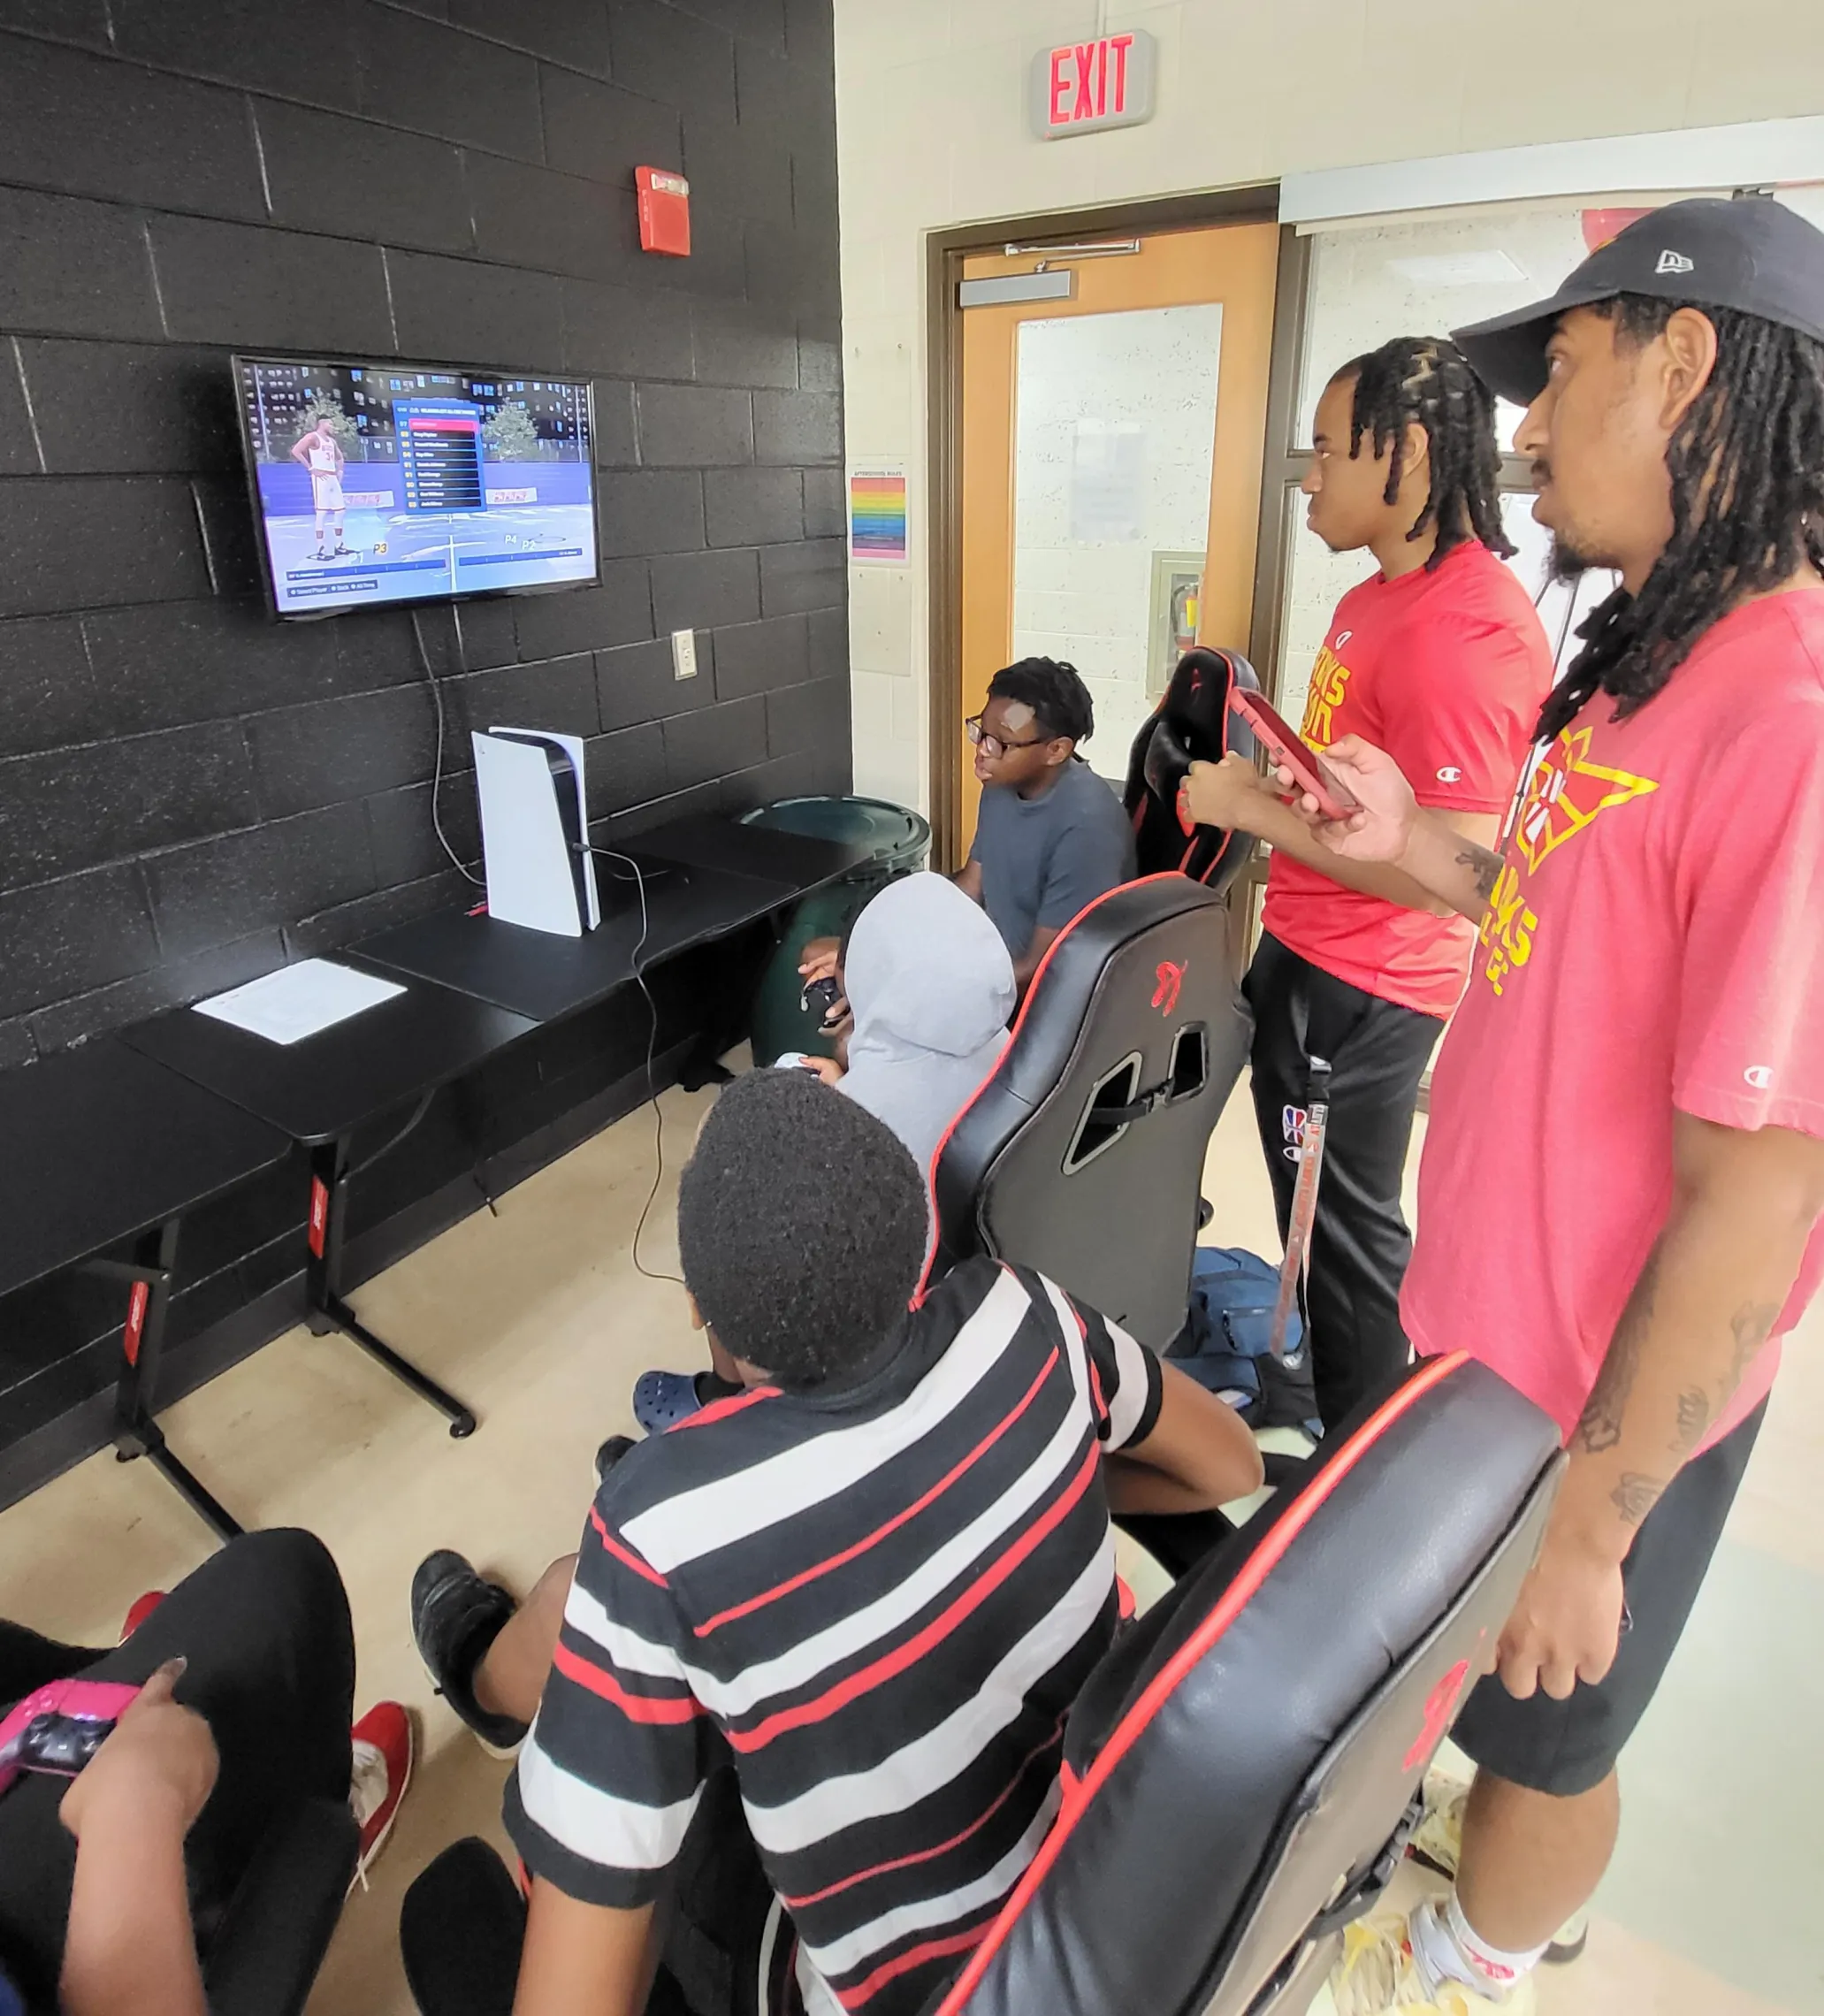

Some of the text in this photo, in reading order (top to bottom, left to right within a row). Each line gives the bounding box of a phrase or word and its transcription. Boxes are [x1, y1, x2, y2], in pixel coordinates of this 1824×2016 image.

[1049, 35, 1133, 124] EXIT
[505, 535, 517, 545] P4
[373, 543, 387, 554] P3
[523, 541, 535, 551] P2
